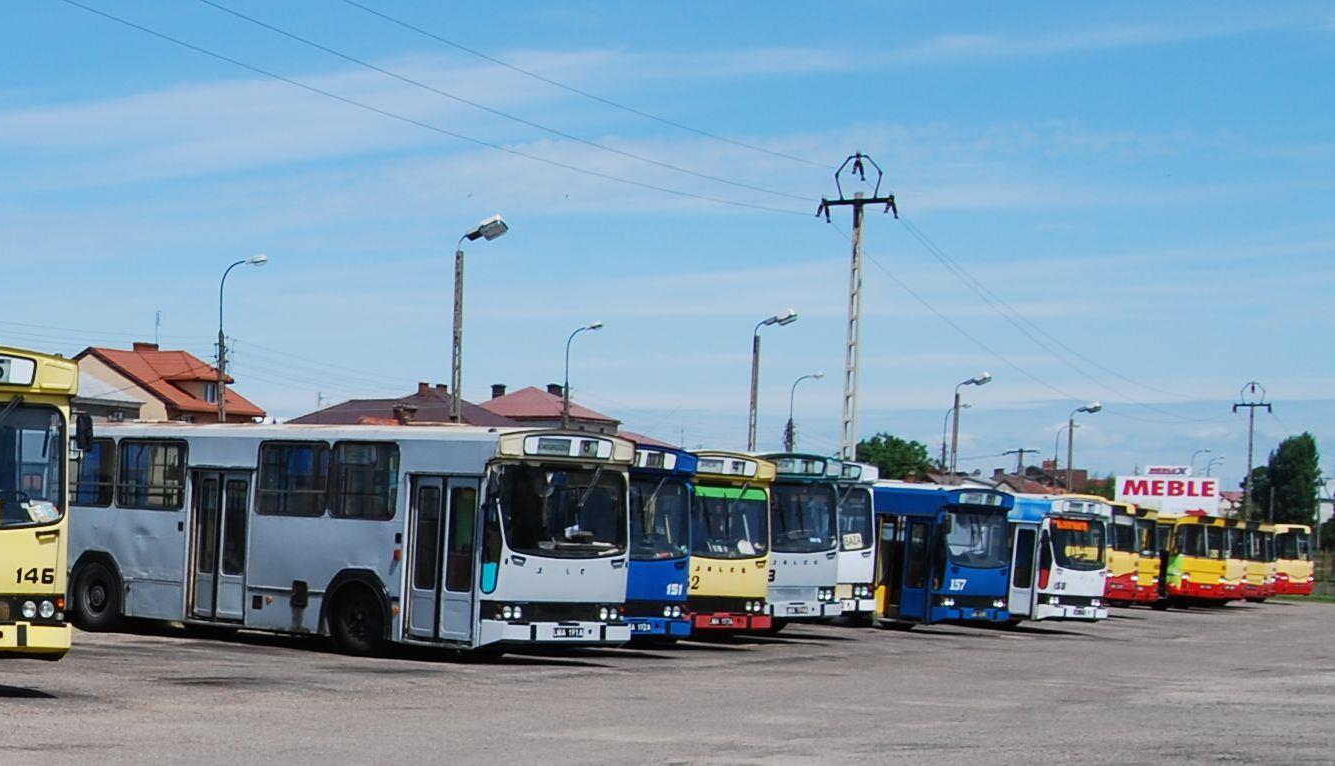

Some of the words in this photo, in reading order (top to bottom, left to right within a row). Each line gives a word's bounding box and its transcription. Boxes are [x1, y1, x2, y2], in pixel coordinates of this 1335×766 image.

[1123, 480, 1215, 497] MEBLE
[16, 568, 54, 584] 146
[666, 583, 683, 596] 151
[949, 579, 966, 590] 157
